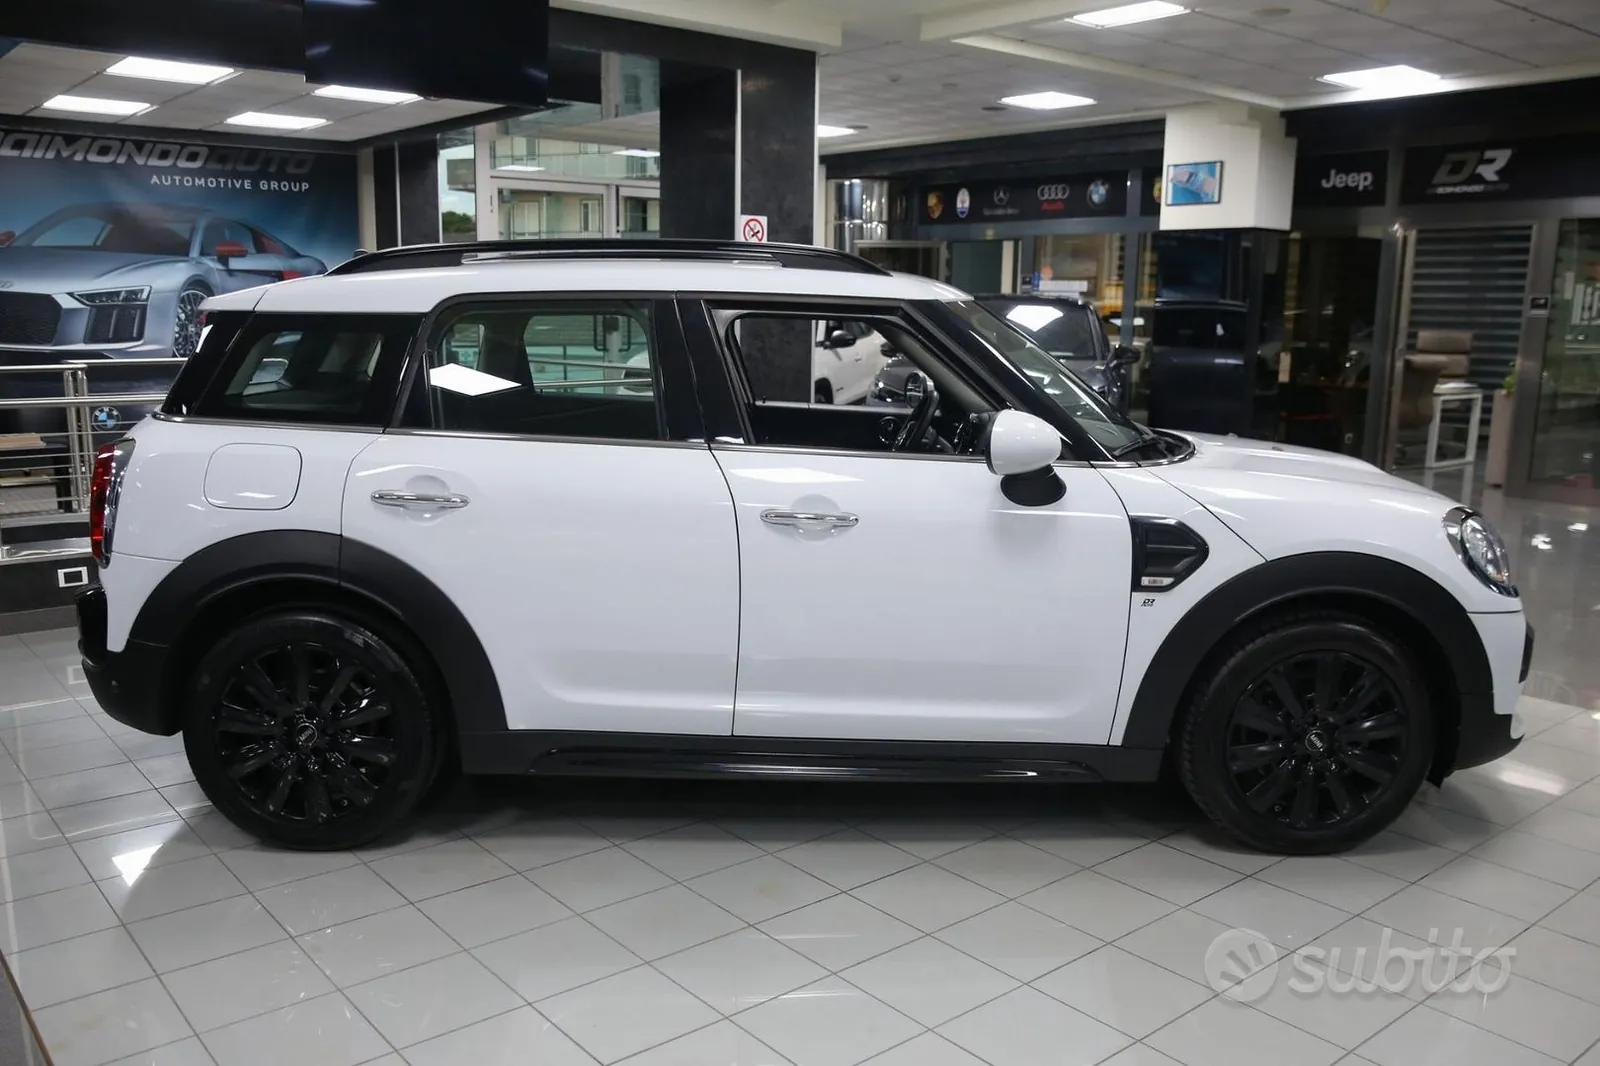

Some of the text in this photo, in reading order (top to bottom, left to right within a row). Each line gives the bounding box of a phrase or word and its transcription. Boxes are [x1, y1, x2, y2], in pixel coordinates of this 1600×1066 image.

[1432, 148, 1512, 184] DR
[150, 174, 311, 192] AUTOMOTIVE GROUP
[1321, 169, 1373, 191] Jeep
